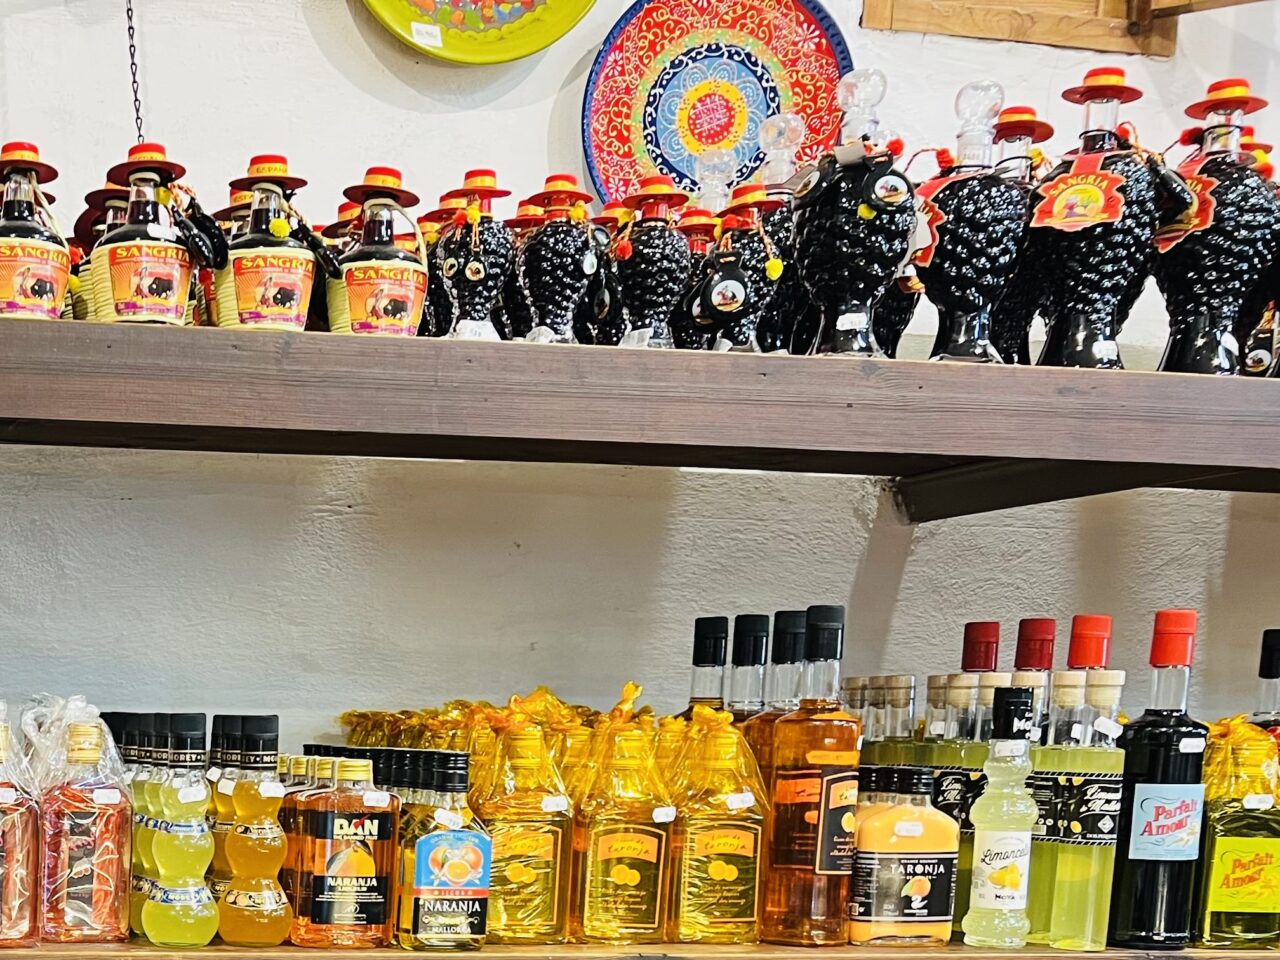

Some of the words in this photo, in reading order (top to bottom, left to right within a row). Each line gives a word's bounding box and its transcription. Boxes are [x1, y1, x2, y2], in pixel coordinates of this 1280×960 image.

[1049, 174, 1109, 196] SANGRIA
[0, 246, 68, 267] SANGRIA
[116, 247, 190, 263] SANGRIA
[241, 256, 314, 273] SANGRIA
[354, 269, 425, 286] SANGRIA
[890, 863, 946, 876] TARONJA
[327, 877, 378, 887] NARANJA
[424, 900, 481, 914] NARANJA
